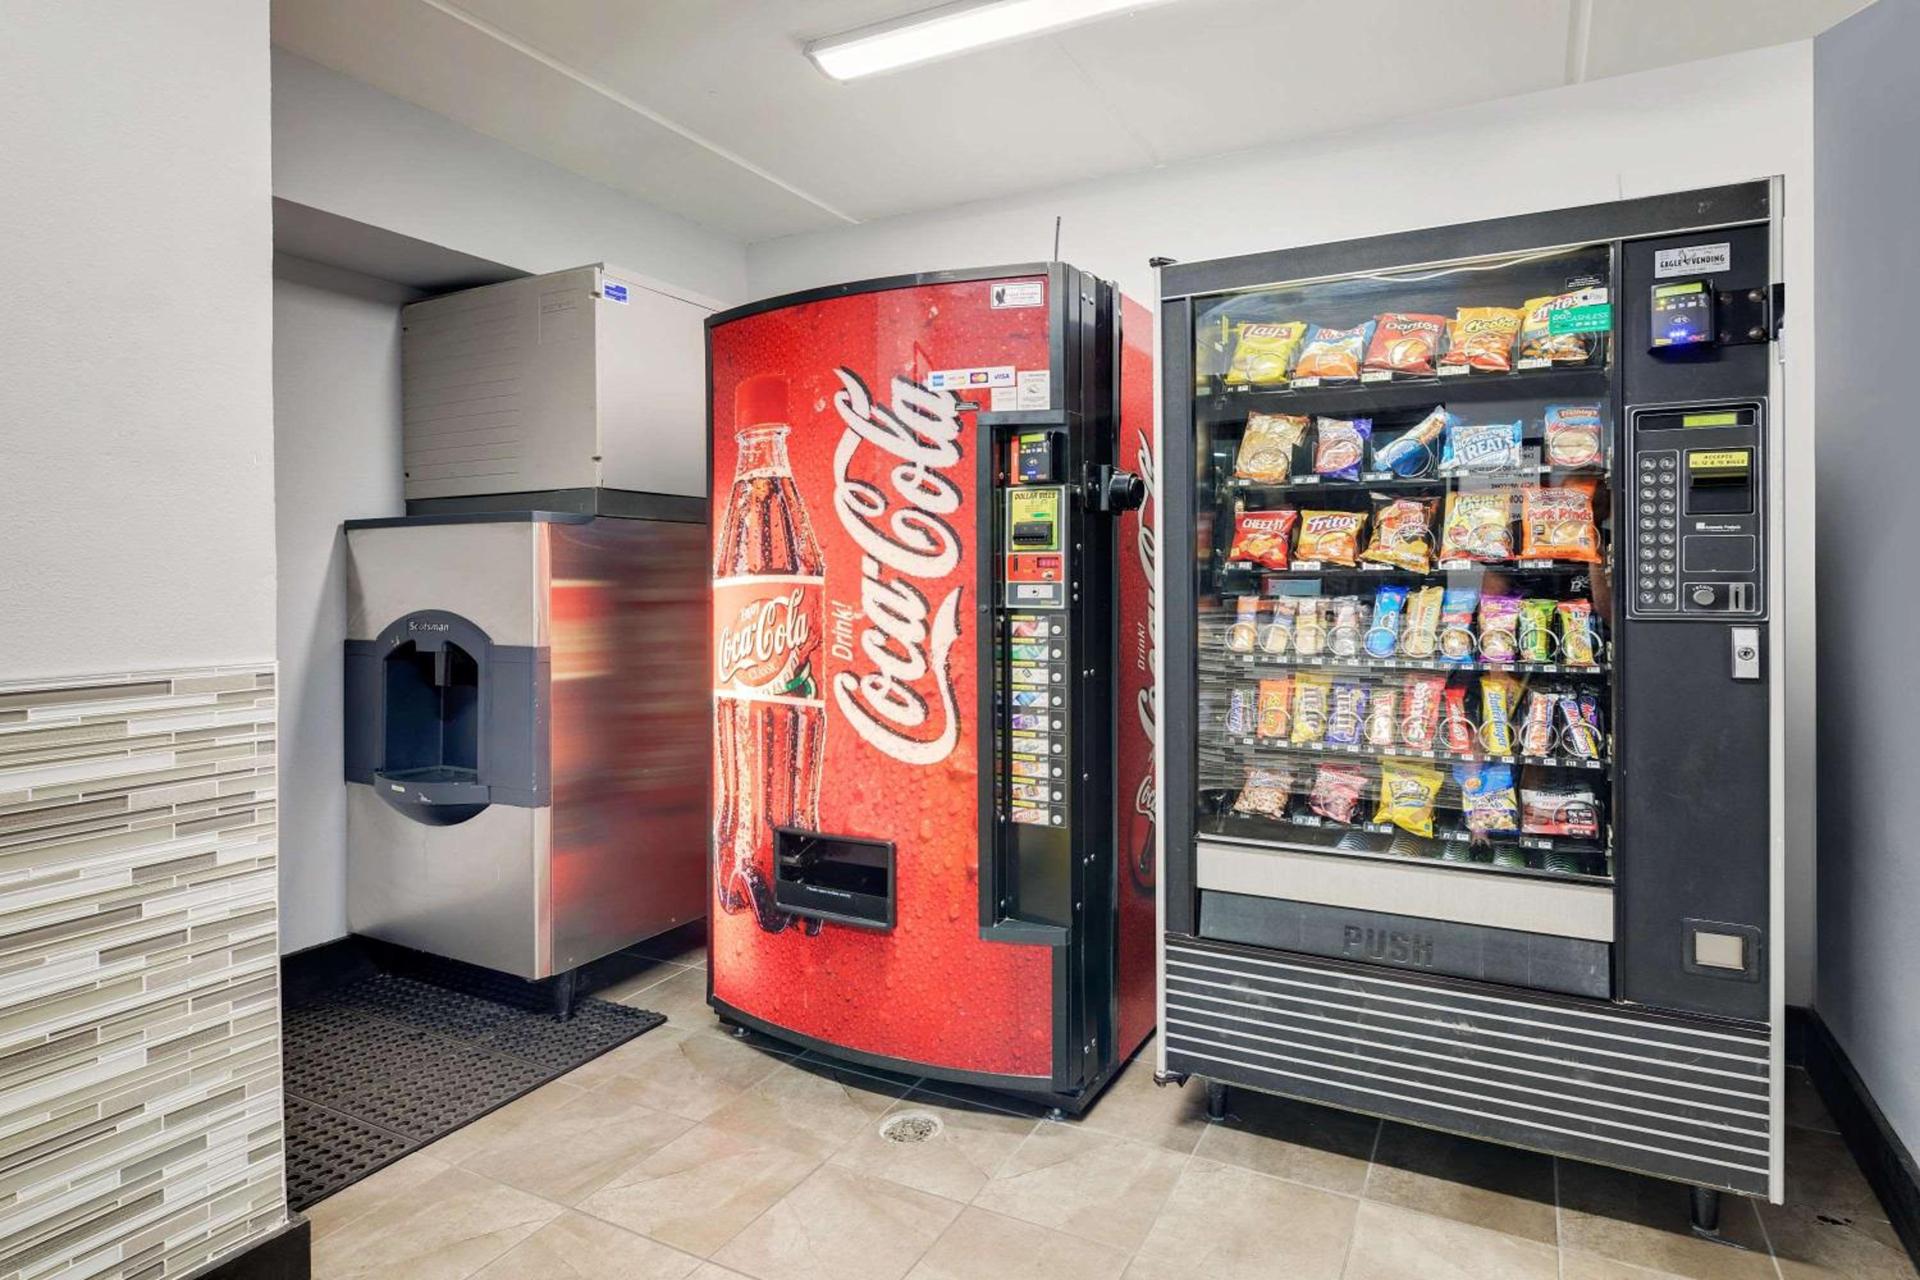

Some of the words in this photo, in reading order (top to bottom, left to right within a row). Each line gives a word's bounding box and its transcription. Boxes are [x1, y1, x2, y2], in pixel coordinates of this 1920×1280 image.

[1660, 257, 1682, 269] EAGLE
[1692, 254, 1725, 265] VENDING
[1386, 320, 1441, 333] Doritos
[1014, 492, 1038, 500] DOLLAR
[1559, 508, 1593, 521] Rinds
[409, 621, 449, 632] Scotsman
[1344, 924, 1434, 968] PUSH
